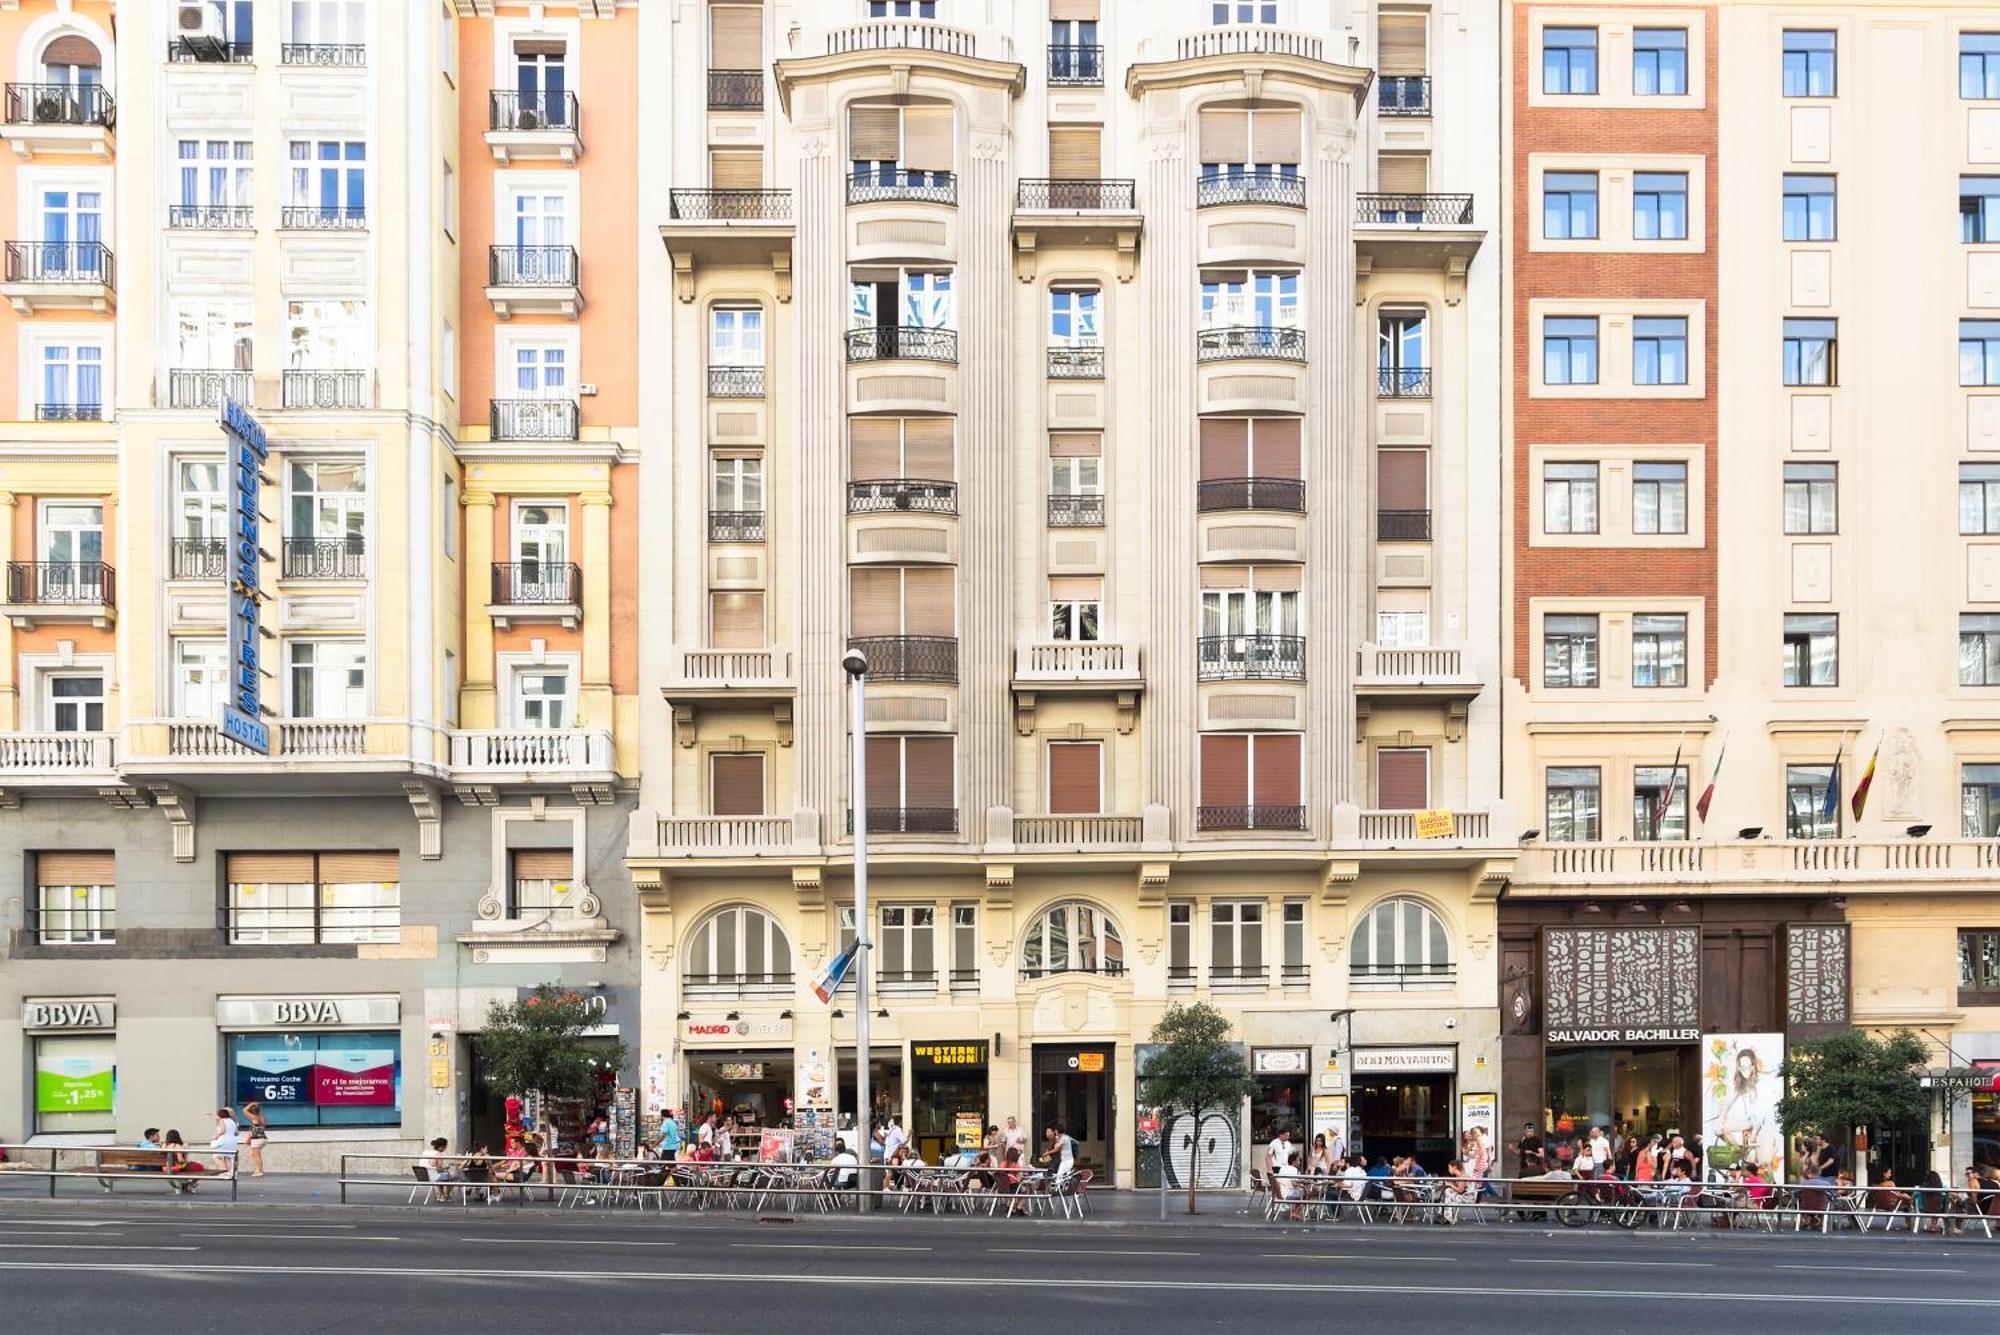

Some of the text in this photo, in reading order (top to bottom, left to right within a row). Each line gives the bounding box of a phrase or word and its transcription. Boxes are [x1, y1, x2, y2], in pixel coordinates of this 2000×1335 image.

[227, 399, 267, 454] HOSTAL
[240, 446, 257, 588] BUENOS
[239, 599, 258, 715] AIRES
[226, 714, 267, 748] HOSTAL
[1577, 931, 1592, 1026] SALVADOR
[1594, 931, 1608, 1026] BACHILLER
[1790, 929, 1804, 1024] SALVADOR
[1804, 929, 1818, 1024] BACHILLER
[34, 1003, 101, 1026] BBVA
[274, 1001, 341, 1023] BBVA
[689, 1025, 730, 1034] MADRID
[914, 1046, 976, 1055] WESTERN
[1548, 1029, 1700, 1042] SALVADOR BACHILLER
[933, 1055, 976, 1064] UNION
